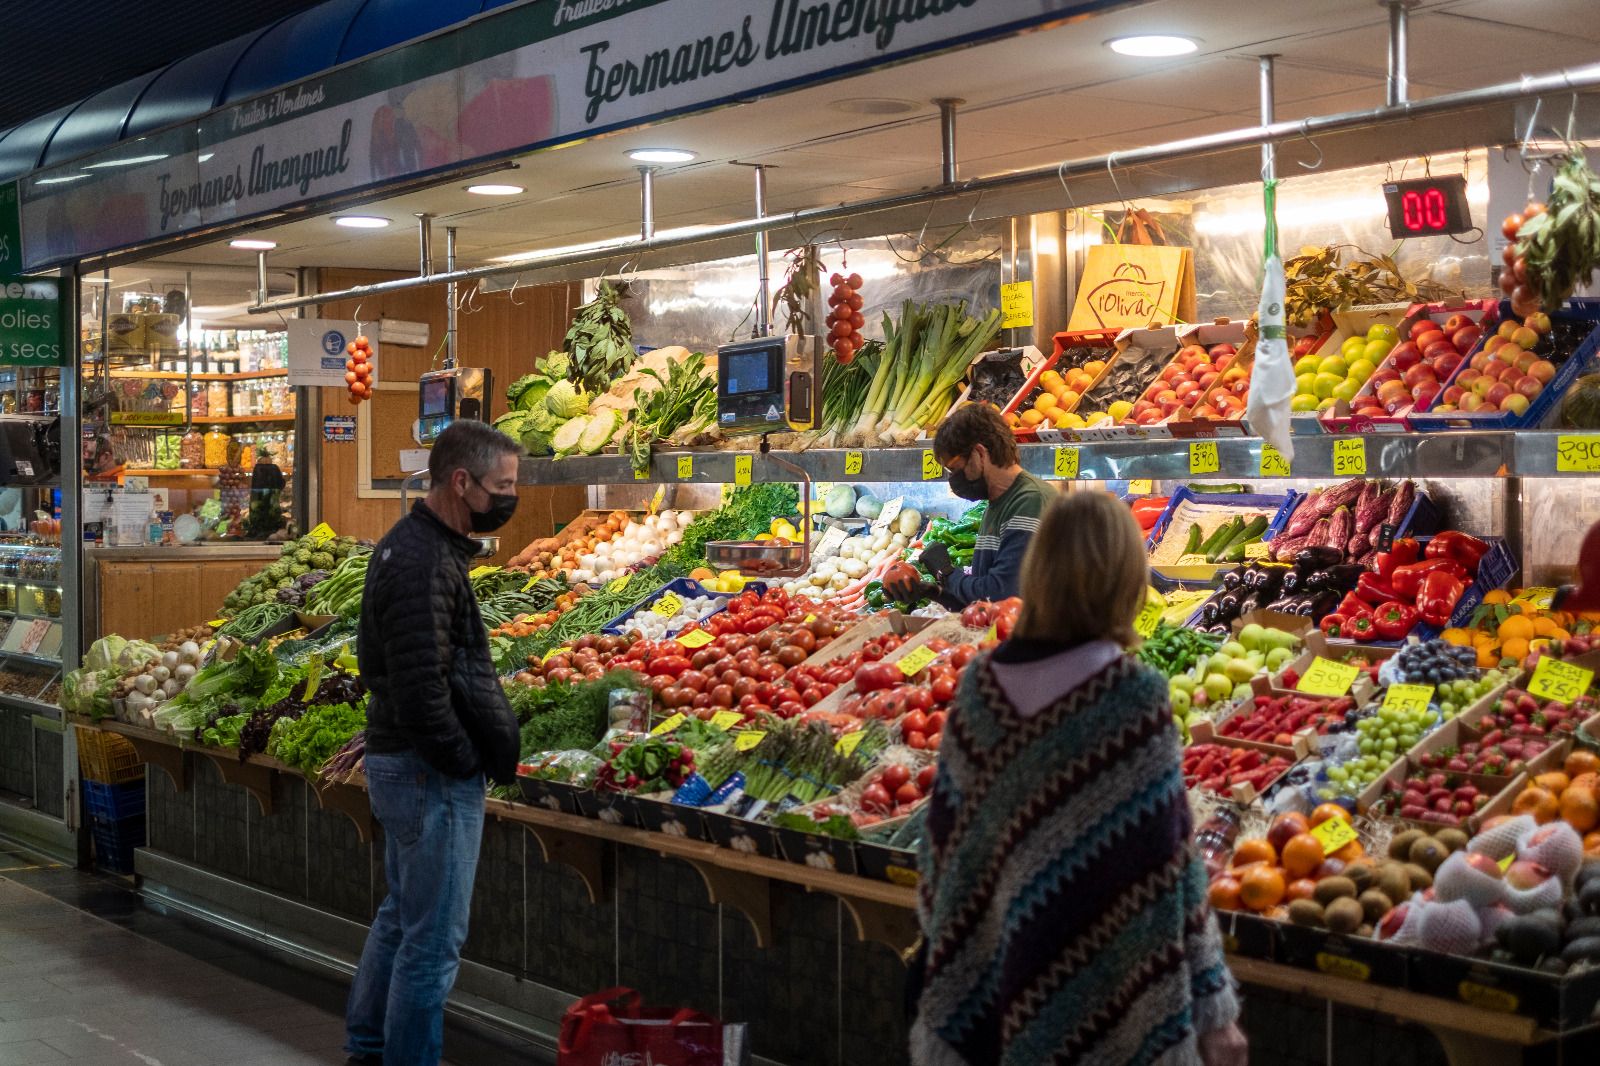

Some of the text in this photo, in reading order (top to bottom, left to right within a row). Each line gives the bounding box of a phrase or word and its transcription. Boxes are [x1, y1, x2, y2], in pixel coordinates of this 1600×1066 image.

[580, 15, 760, 124] Germanes
[157, 118, 353, 231] Germanes Amengual
[1402, 187, 1447, 231] 00
[11, 343, 60, 358] secs
